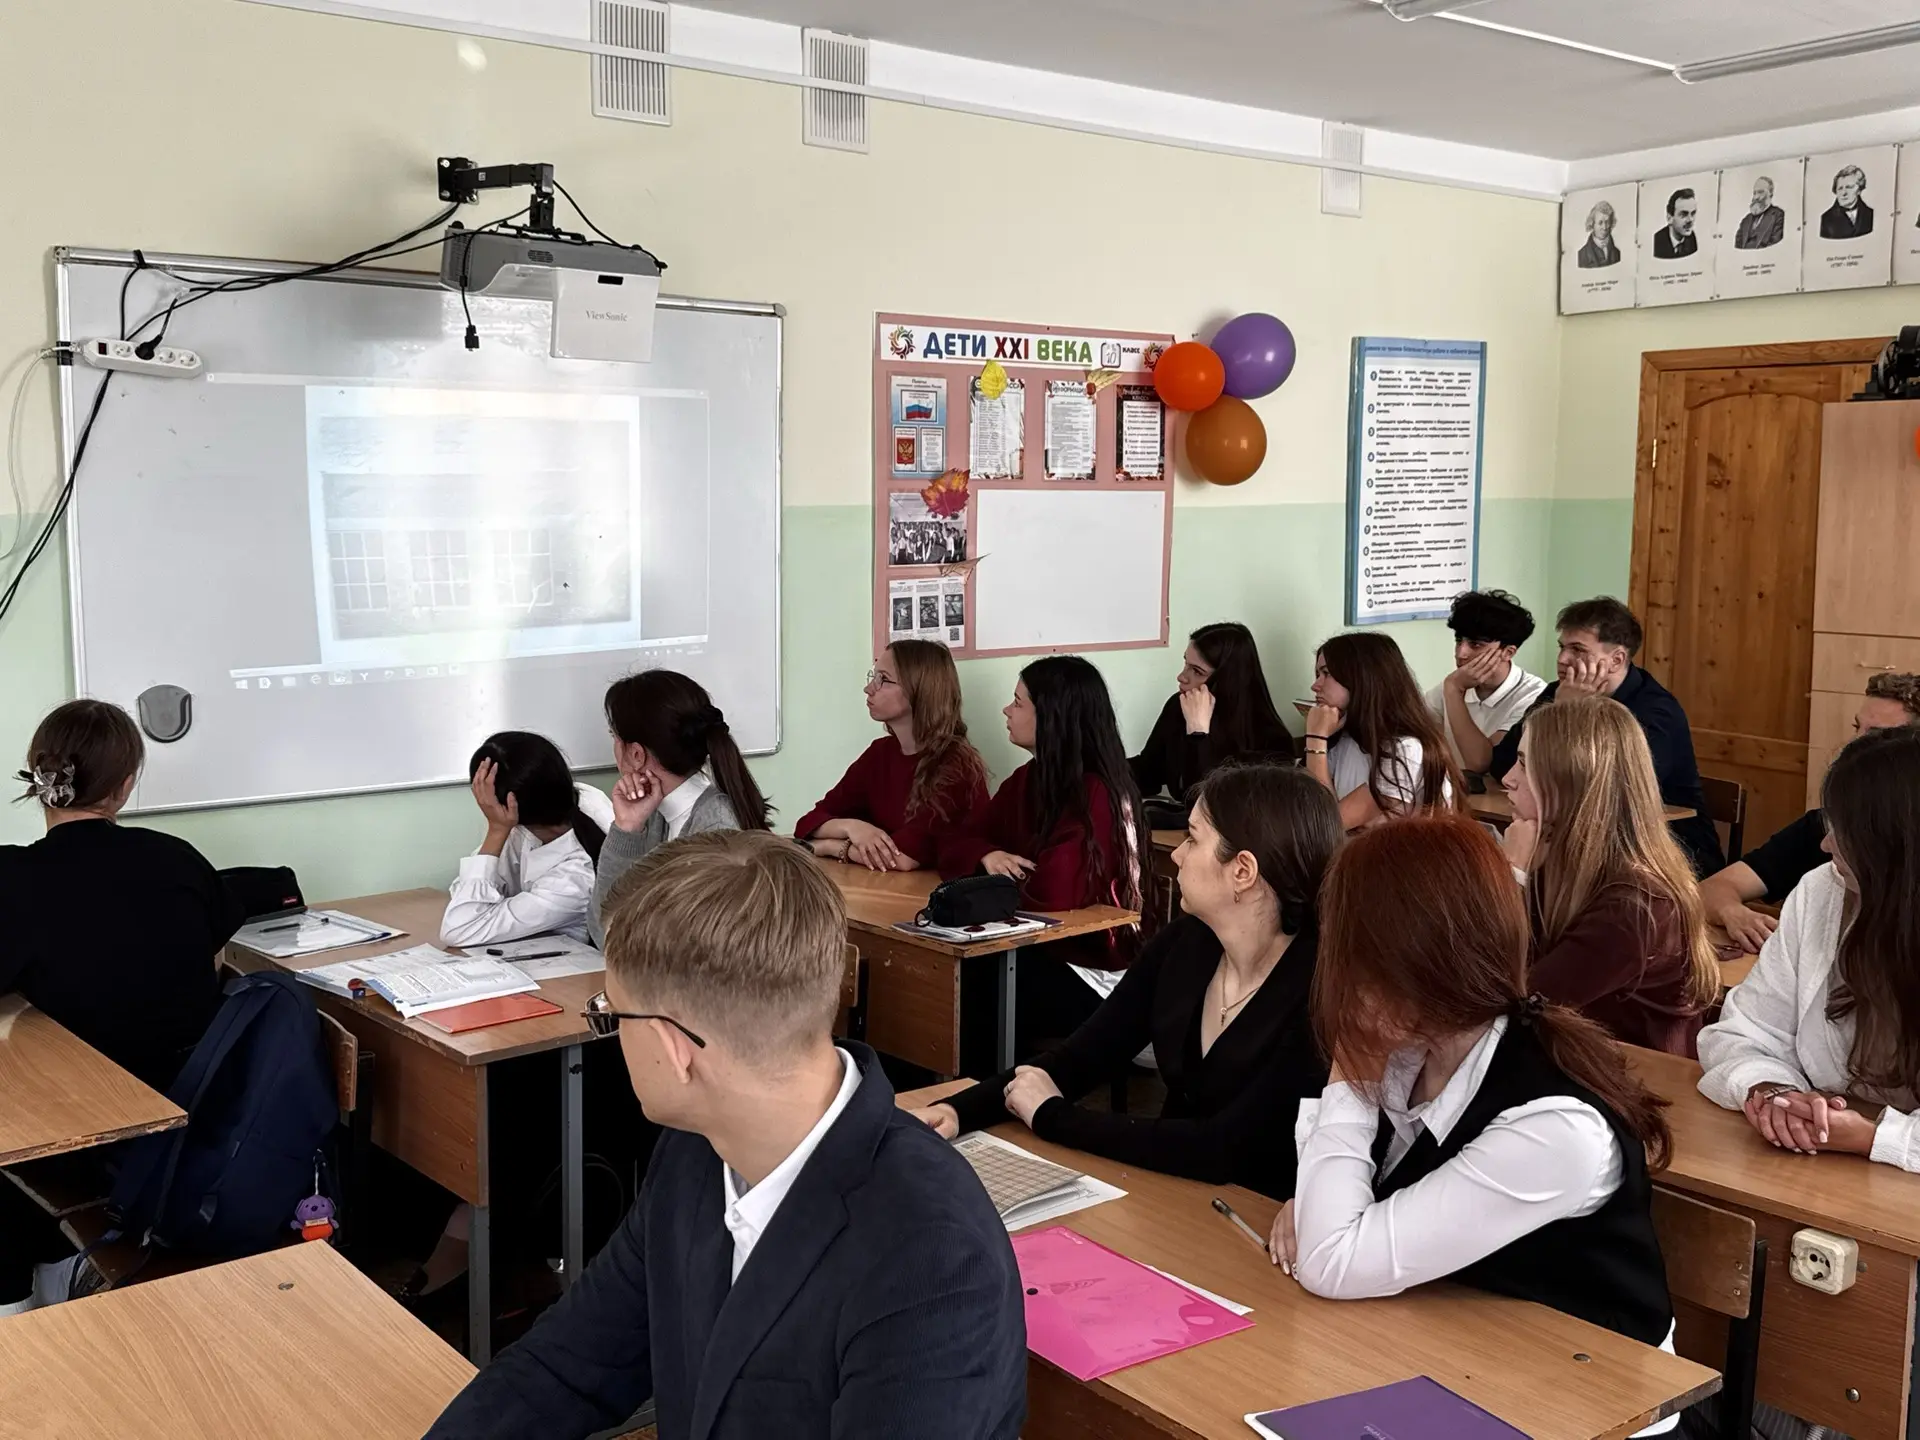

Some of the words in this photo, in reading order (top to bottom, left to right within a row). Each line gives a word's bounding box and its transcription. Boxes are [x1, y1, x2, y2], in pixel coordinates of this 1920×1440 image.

[585, 310, 628, 322] ViewSonic
[923, 332, 986, 359] ДЕТИ
[994, 336, 1029, 360] XXI
[1037, 339, 1093, 363] ВЕКА
